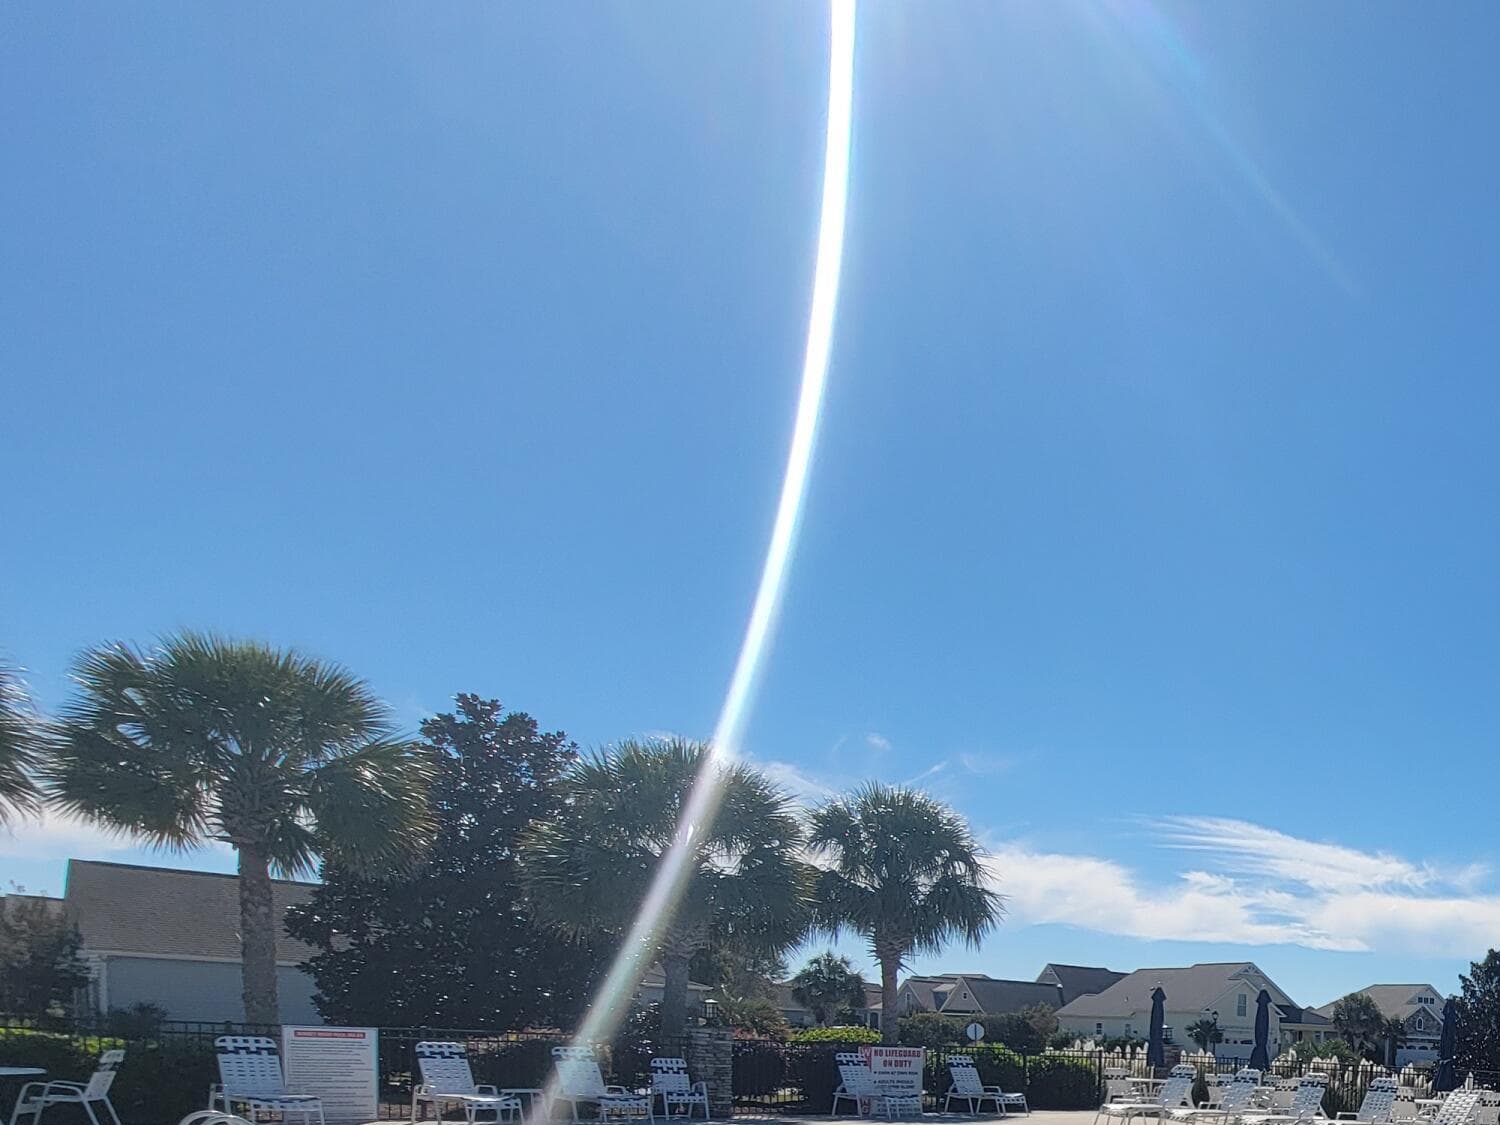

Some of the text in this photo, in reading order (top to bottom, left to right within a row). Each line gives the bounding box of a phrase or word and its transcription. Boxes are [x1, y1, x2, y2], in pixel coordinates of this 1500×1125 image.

[874, 1049, 921, 1057] NO LIFEGUARD
[894, 1060, 912, 1068] DUTY
